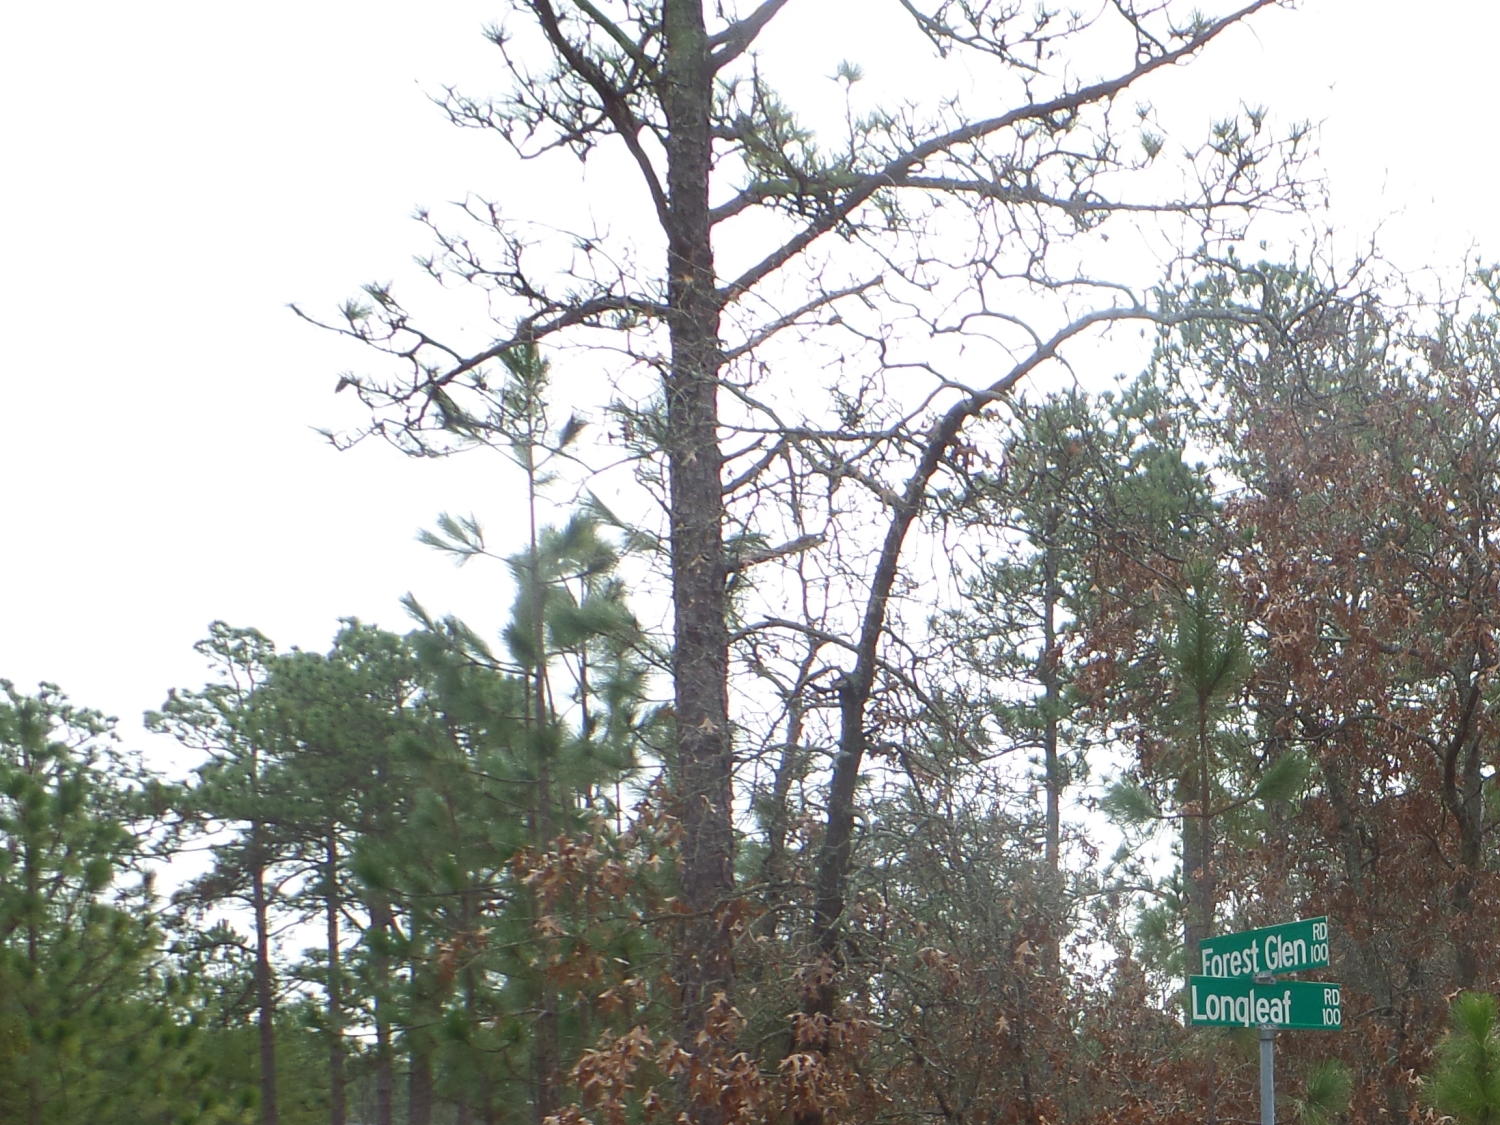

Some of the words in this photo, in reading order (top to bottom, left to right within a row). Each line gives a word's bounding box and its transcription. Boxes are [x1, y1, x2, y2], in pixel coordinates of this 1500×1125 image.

[1312, 922, 1328, 941] RD
[1202, 939, 1260, 978] Forest
[1265, 934, 1306, 970] Glen
[1310, 943, 1328, 963] 100
[1191, 985, 1291, 1028] Longleaf
[1324, 988, 1340, 1006] RD
[1322, 1008, 1341, 1025] 100
